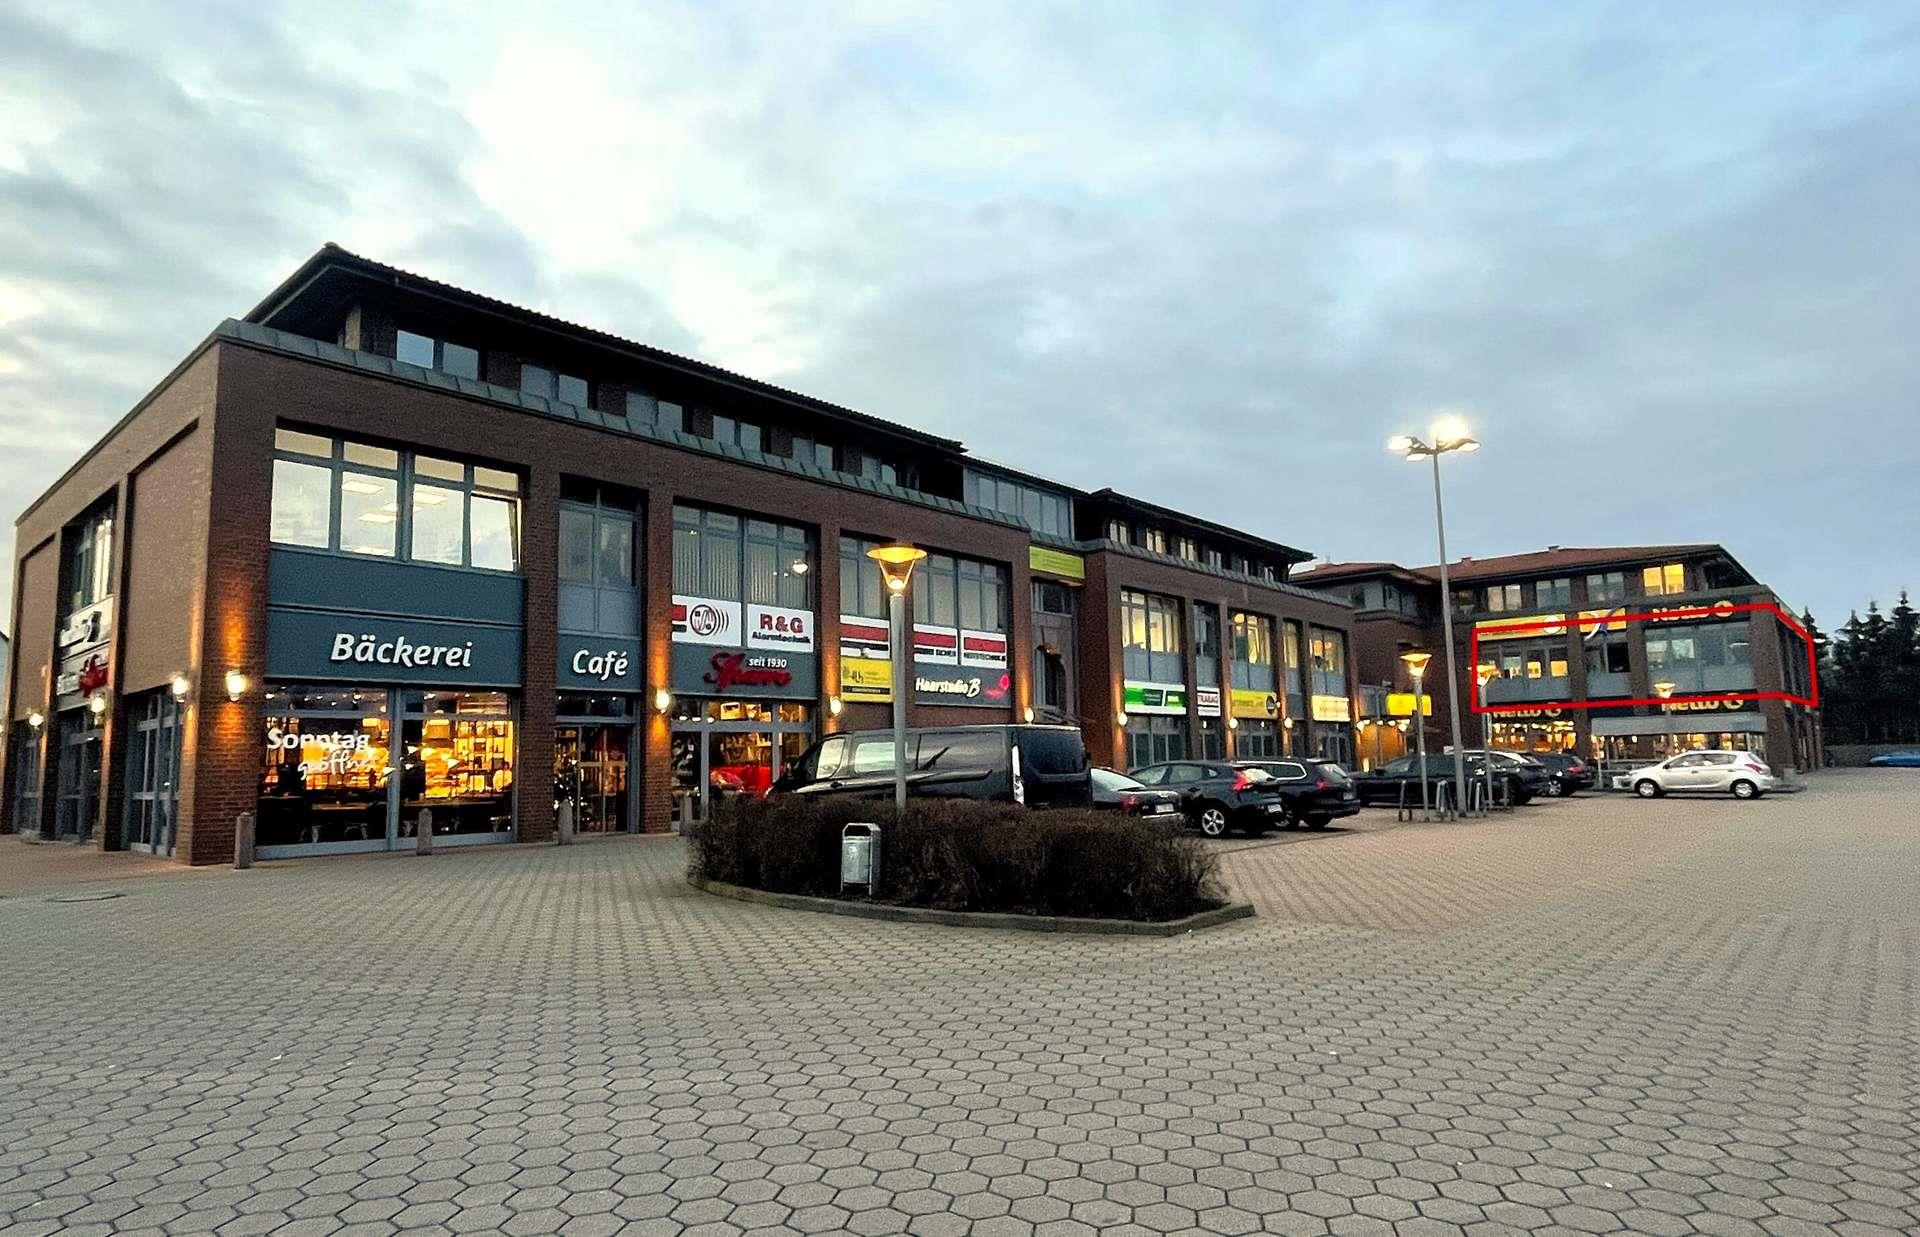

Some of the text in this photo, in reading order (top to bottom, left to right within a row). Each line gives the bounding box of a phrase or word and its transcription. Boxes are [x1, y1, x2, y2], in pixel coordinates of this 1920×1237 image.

[330, 632, 473, 669] Bäckerei
[748, 656, 787, 668] seit 1930
[572, 647, 629, 681] Café
[915, 677, 968, 693] Haarstudio
[266, 728, 371, 752] Sonntag
